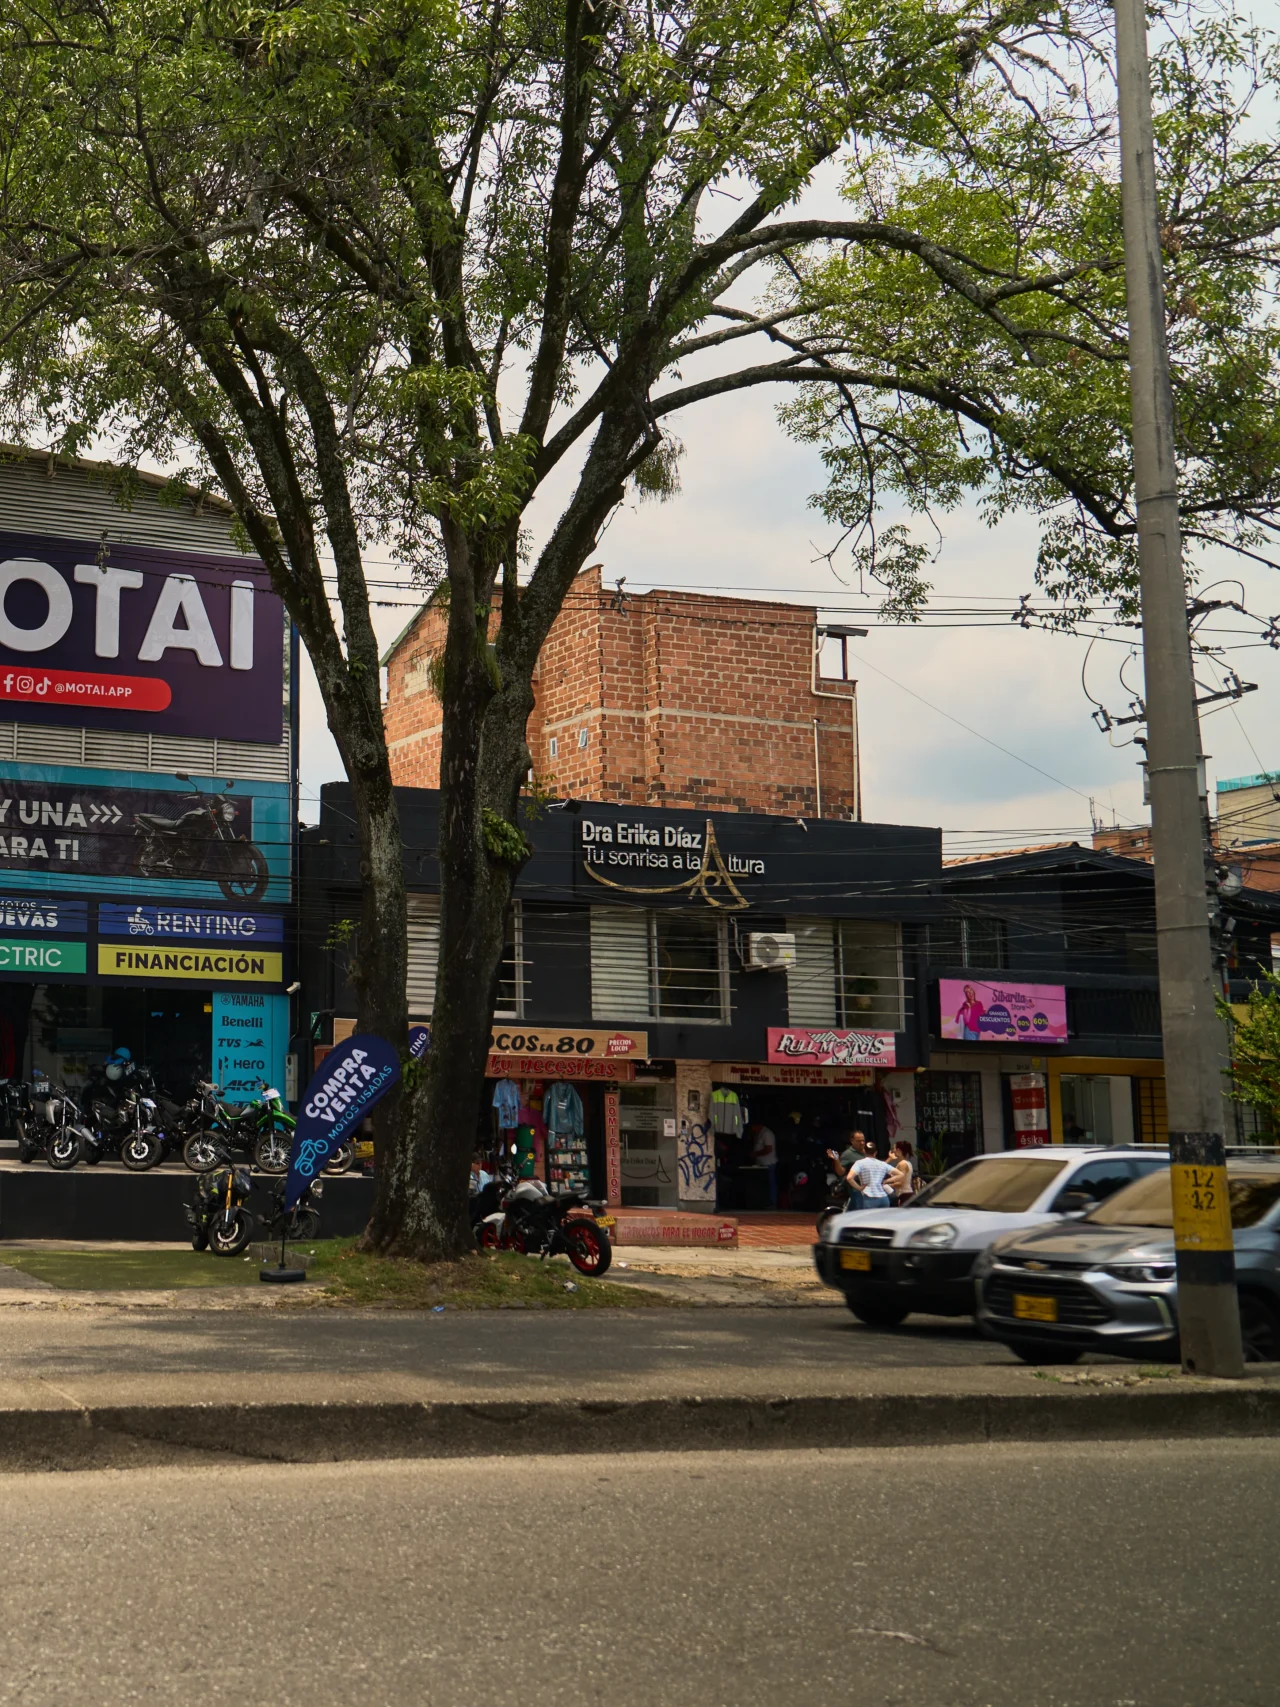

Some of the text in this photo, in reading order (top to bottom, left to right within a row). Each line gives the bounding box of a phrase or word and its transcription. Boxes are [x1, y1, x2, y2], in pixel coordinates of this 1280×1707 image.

[54, 682, 132, 697] @MOTAI.APP
[19, 800, 88, 828] UNA
[582, 820, 702, 848] Dra Erika Díaz
[55, 838, 79, 861] TI
[582, 845, 604, 863] Tu
[608, 849, 669, 868] sonrisa
[672, 856, 683, 869] a
[686, 851, 701, 870] la
[157, 912, 257, 936] RENTING
[116, 952, 264, 975] FINANCIACIÓN
[231, 994, 265, 1007] YAMAHA
[1011, 1003, 1026, 1011] Store
[222, 1015, 263, 1028] Benelli
[1033, 1018, 1048, 1026] 60%
[217, 1038, 241, 1048] TVS
[409, 1032, 427, 1055] TING
[556, 1036, 595, 1054] 80
[776, 1034, 819, 1056] FULL
[489, 1055, 617, 1077] tu necesitas
[223, 1080, 259, 1092] AKT
[305, 1048, 368, 1118] COMPRA
[320, 1064, 376, 1122] VENTA
[328, 1104, 360, 1140] MOTOS
[357, 1065, 393, 1105] USADAS
[608, 1097, 617, 1197] DOMICILIOS
[1020, 1135, 1043, 1145] ésika
[662, 1226, 680, 1238] PARA
[682, 1227, 691, 1238] EL
[691, 1226, 716, 1239] HOGAR
